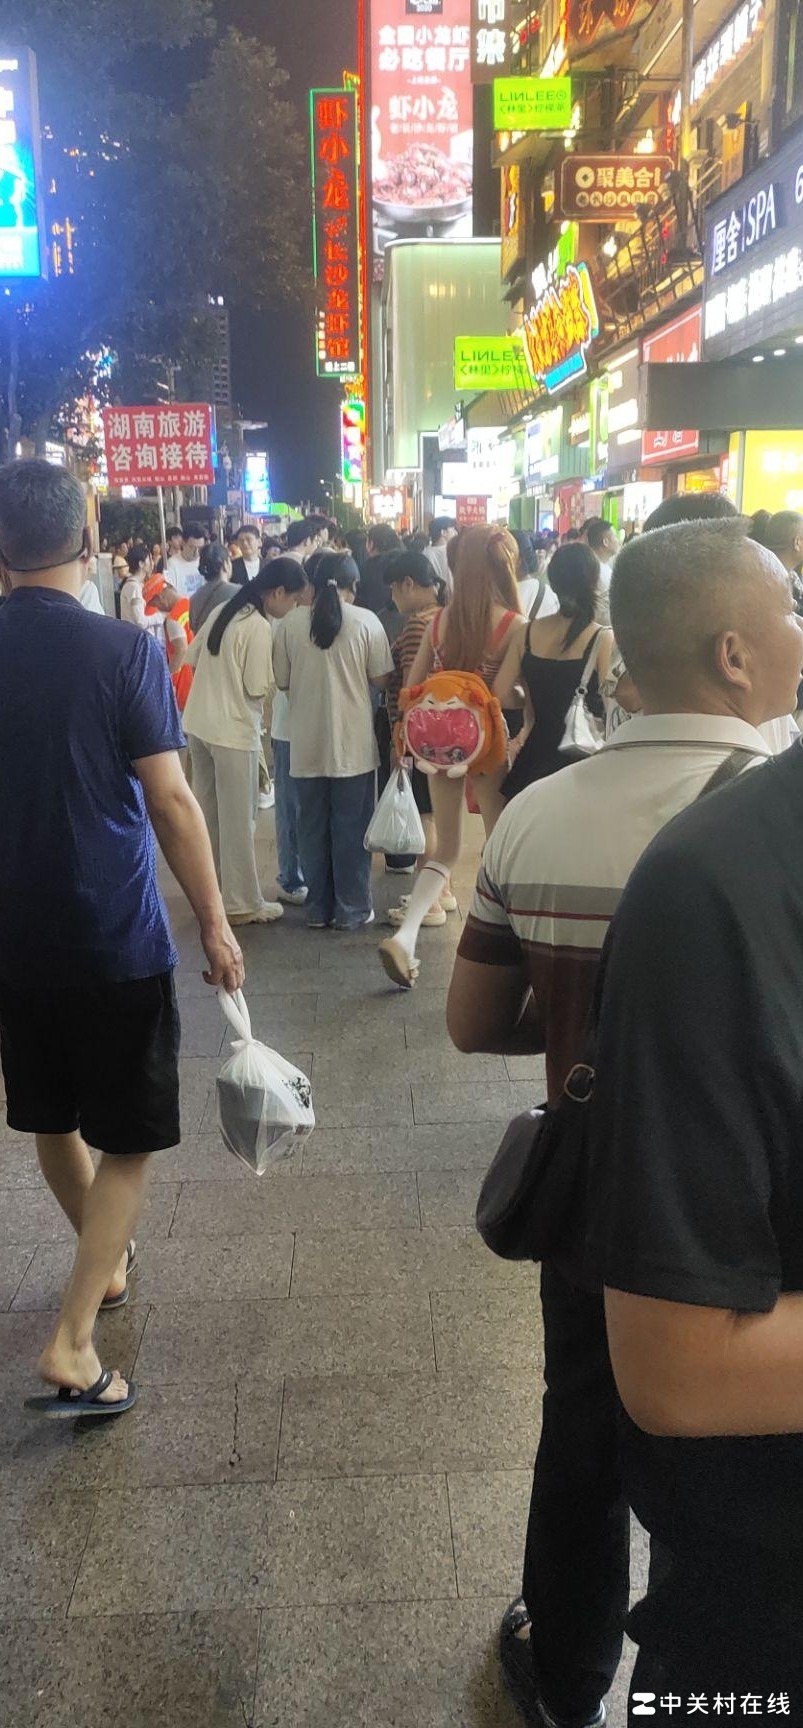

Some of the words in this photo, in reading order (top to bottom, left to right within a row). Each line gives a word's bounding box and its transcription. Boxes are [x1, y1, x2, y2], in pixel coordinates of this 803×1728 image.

[378, 24, 470, 46] 全国小龙虾
[378, 46, 470, 72] 必吃餐厅
[388, 86, 459, 121] 虾小龙
[746, 183, 777, 247] SPA
[108, 410, 206, 439] 湖南旅游
[111, 441, 208, 472] 咨询接待
